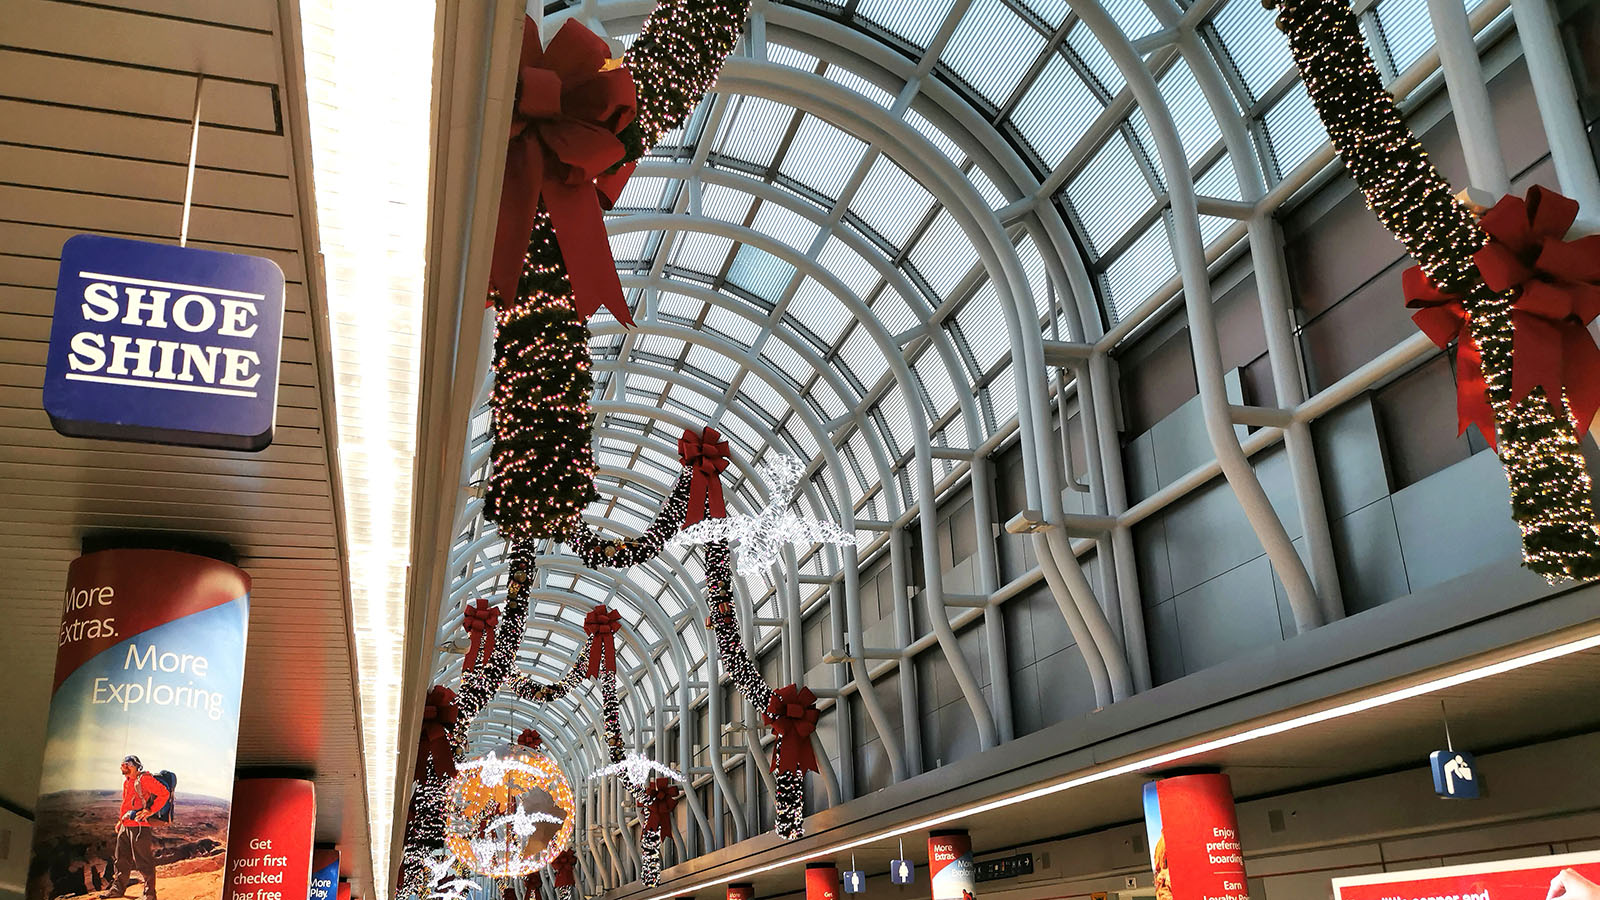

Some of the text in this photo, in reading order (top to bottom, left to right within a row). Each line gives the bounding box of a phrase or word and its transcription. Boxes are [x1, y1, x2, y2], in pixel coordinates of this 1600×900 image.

[81, 282, 259, 338] SHOE
[67, 332, 261, 388] SHINE
[124, 644, 209, 677] More
[1213, 827, 1235, 839] Enjoy
[249, 838, 272, 850] Get
[232, 854, 288, 872] your first
[233, 871, 283, 885] checked
[1223, 880, 1243, 891] Earn
[256, 888, 282, 900] free
